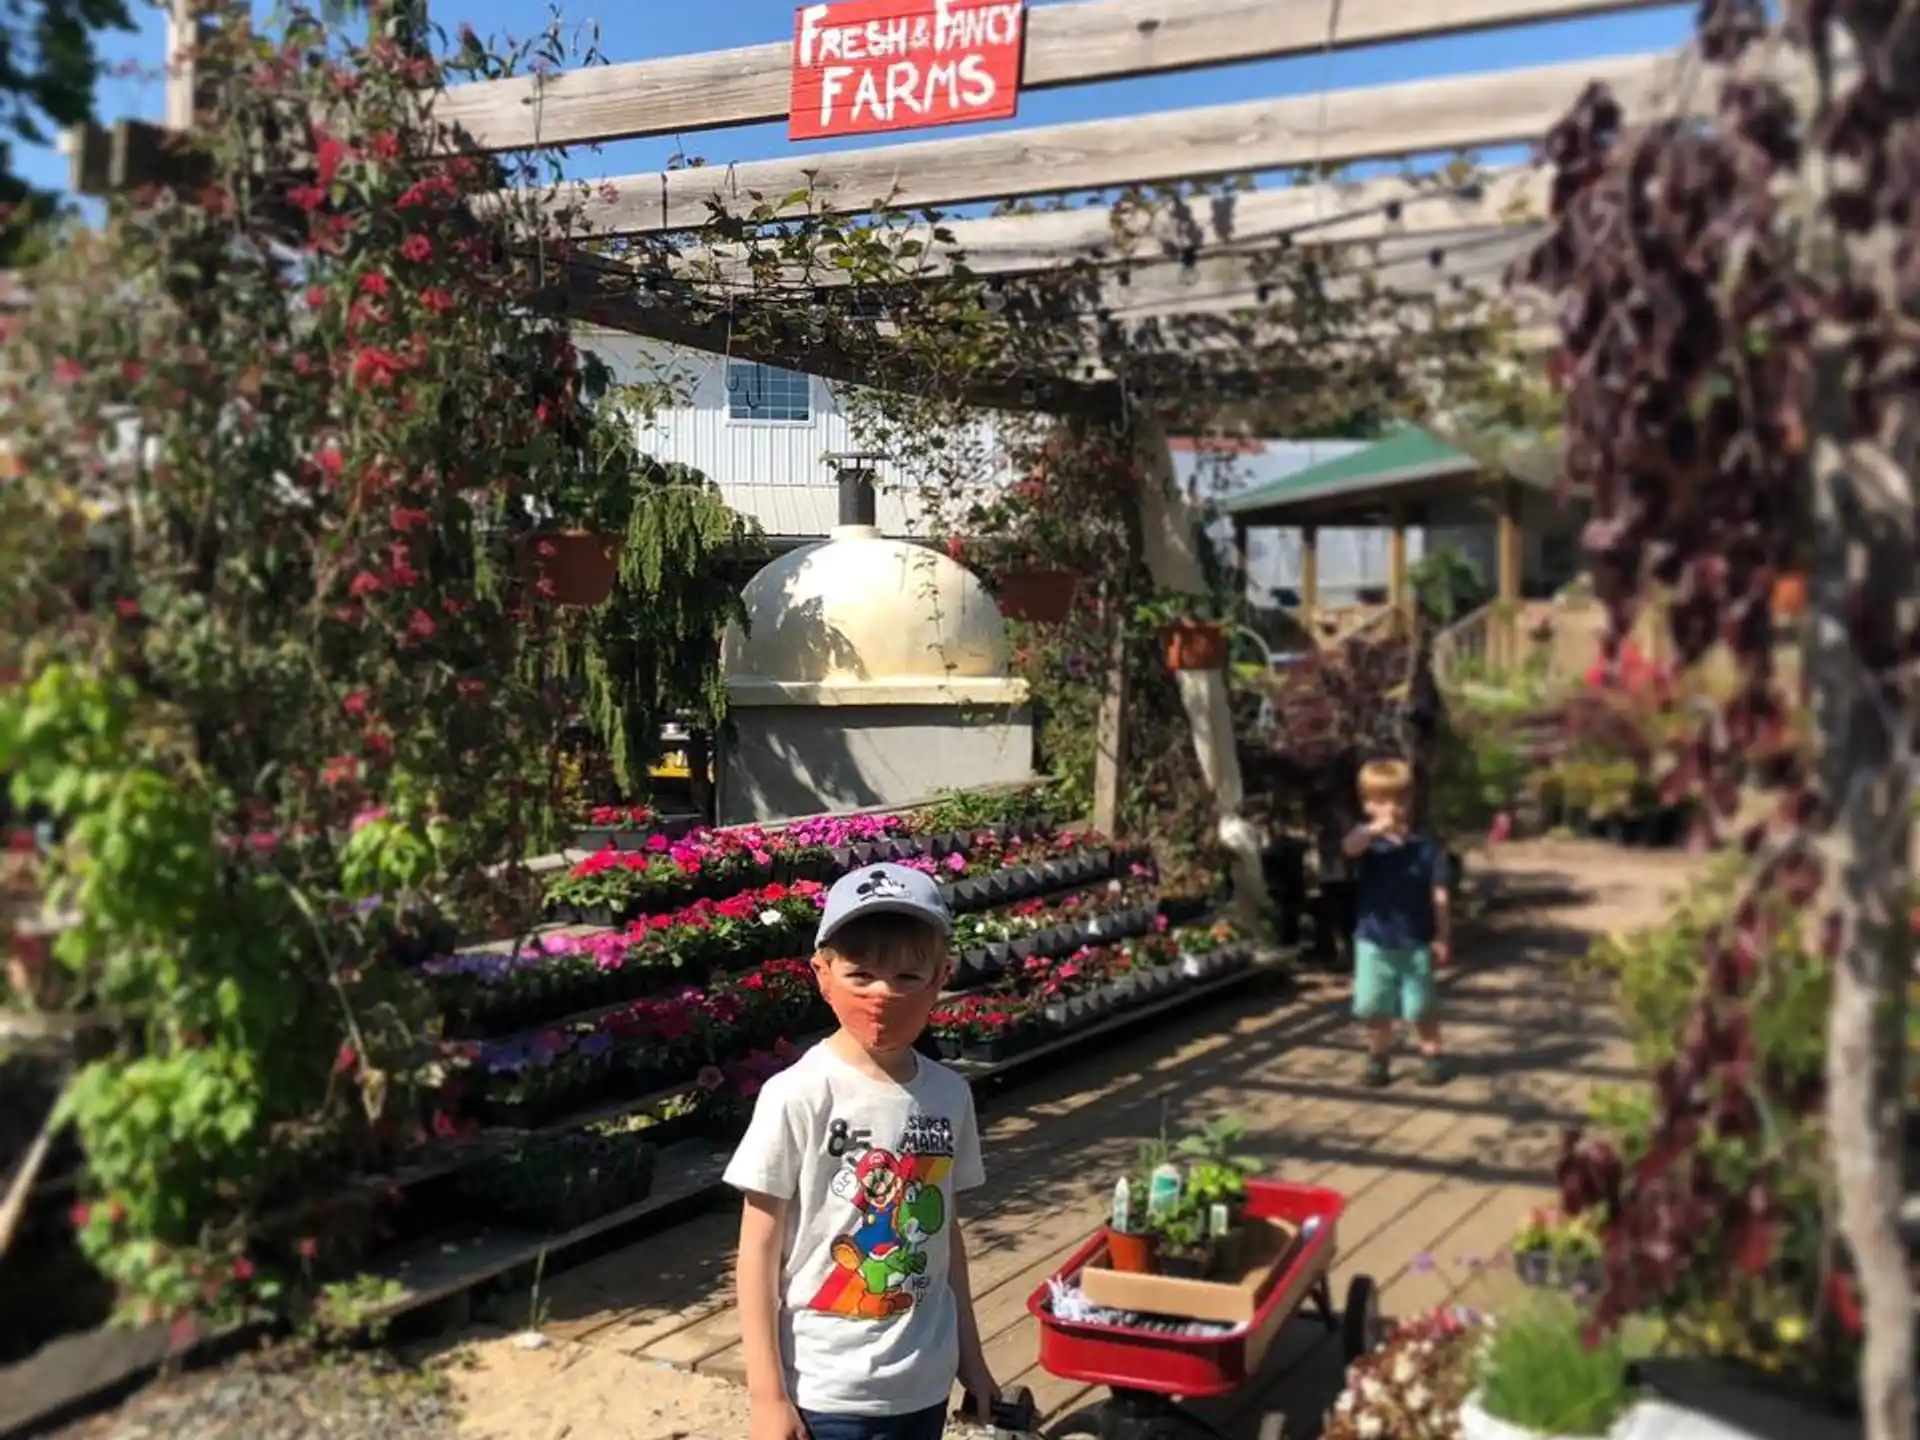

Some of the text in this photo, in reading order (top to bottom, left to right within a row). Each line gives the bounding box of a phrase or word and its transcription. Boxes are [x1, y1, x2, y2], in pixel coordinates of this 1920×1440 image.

[800, 0, 1022, 67] FRESH & FANCY
[820, 53, 996, 127] FARMS
[908, 1114, 951, 1132] SUPER
